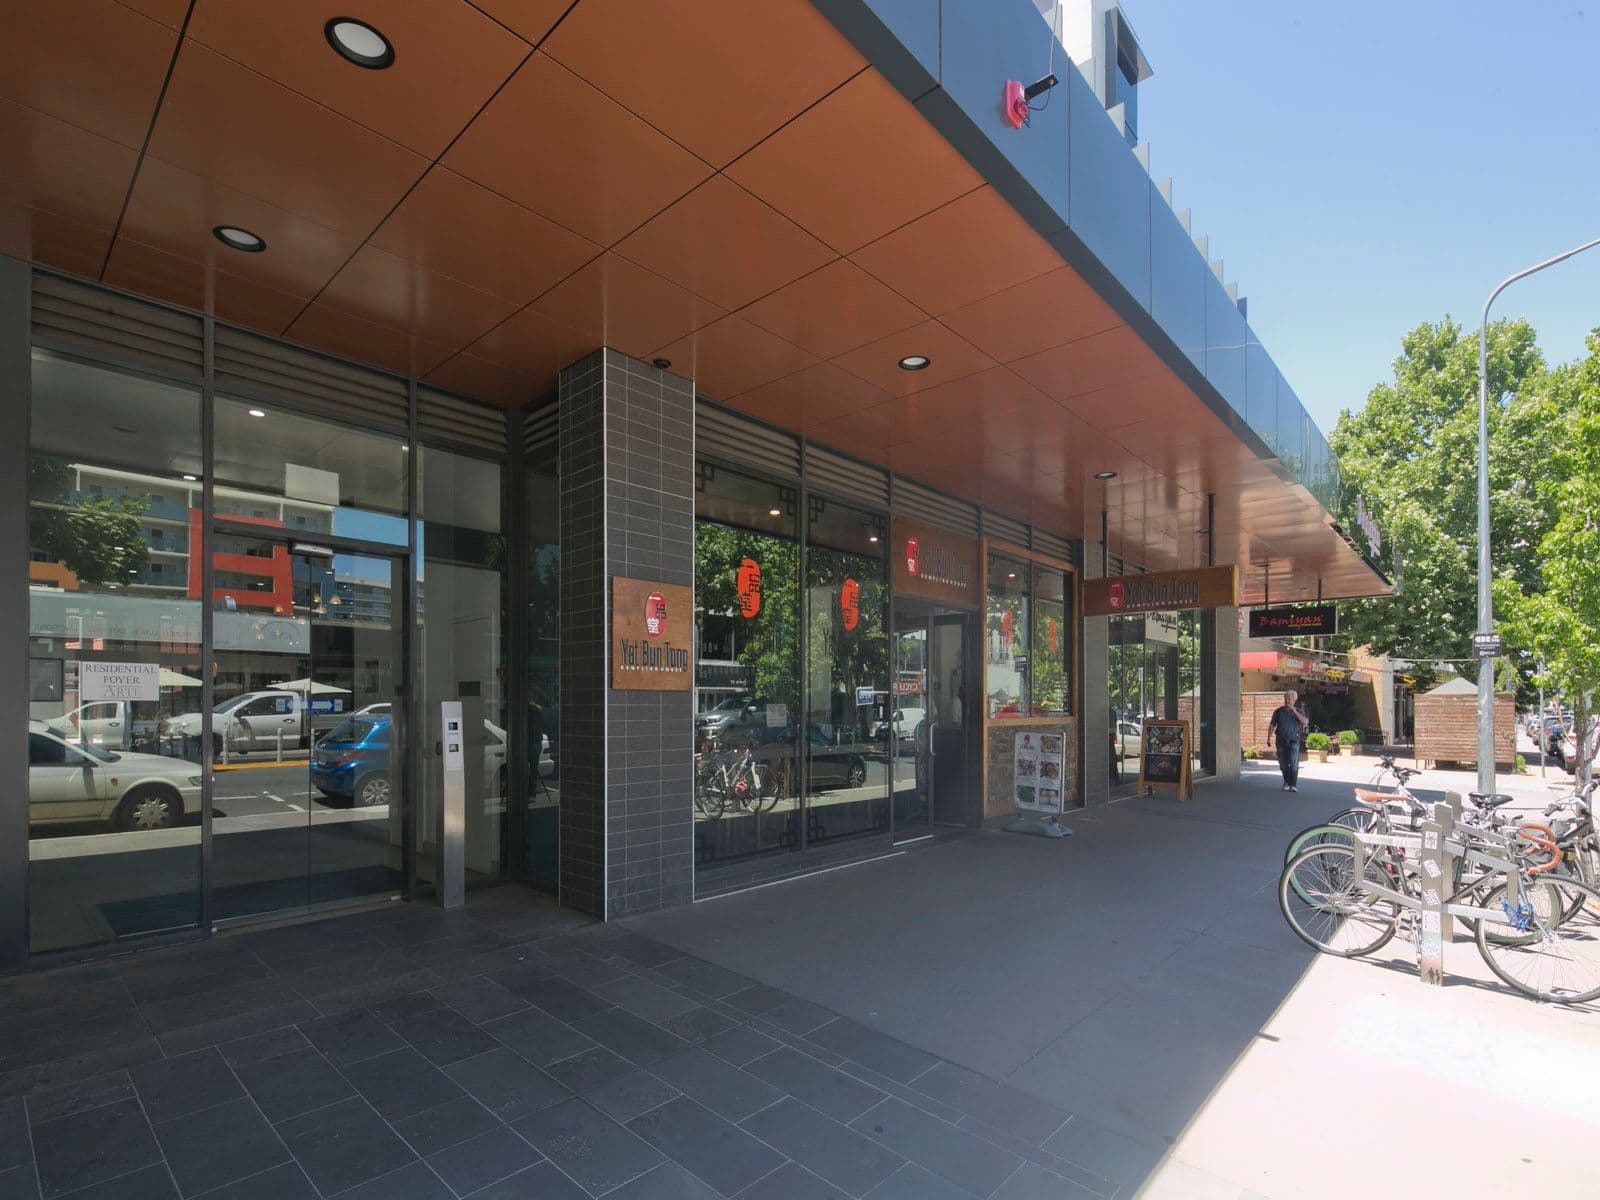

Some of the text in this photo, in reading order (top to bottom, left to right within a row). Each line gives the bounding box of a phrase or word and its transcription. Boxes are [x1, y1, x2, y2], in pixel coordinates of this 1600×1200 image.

[1259, 613, 1323, 630] Bamiyan
[621, 639, 688, 673] Yat Bun Tong
[85, 663, 157, 675] RESIDENTIAL
[103, 675, 139, 685] FOYER
